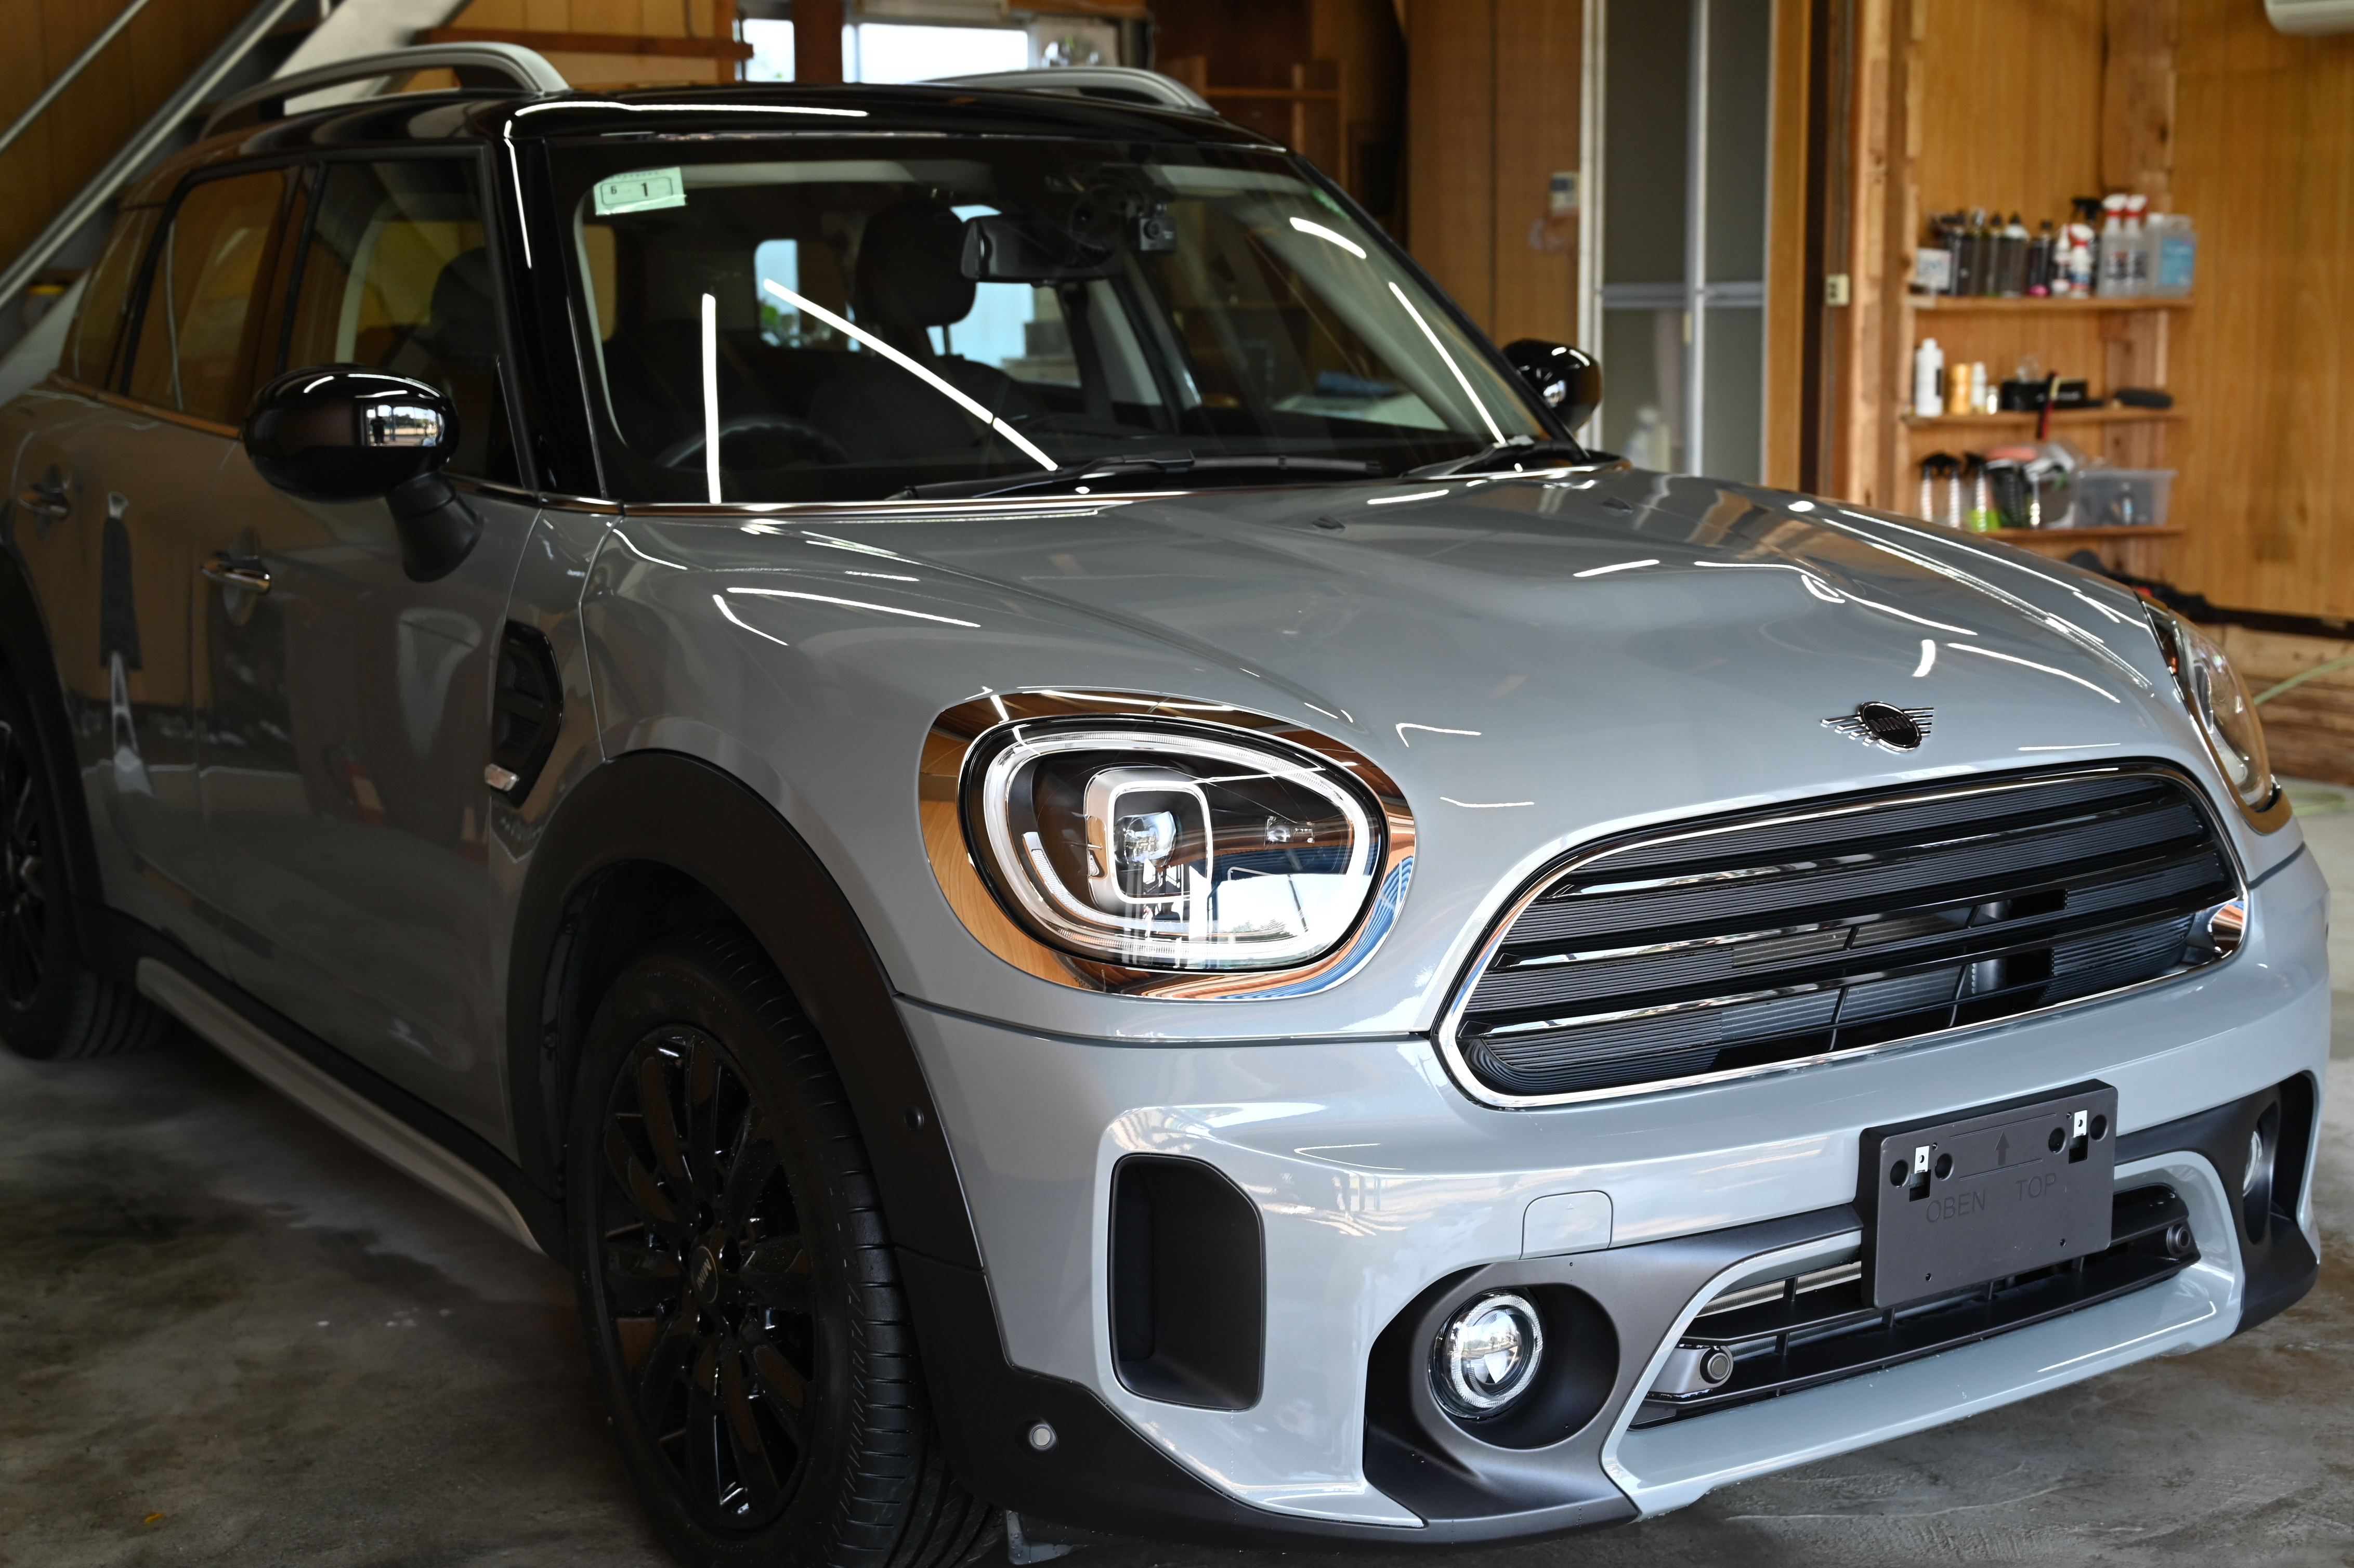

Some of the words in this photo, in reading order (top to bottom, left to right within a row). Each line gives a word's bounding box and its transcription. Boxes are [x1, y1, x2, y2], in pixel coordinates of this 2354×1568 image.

[610, 185, 617, 194] 6
[640, 182, 648, 197] 1
[1869, 716, 1912, 732] MINI
[1926, 1189, 1986, 1223] OBEN
[2015, 1172, 2057, 1201] TOP
[697, 1258, 712, 1291] MINI
